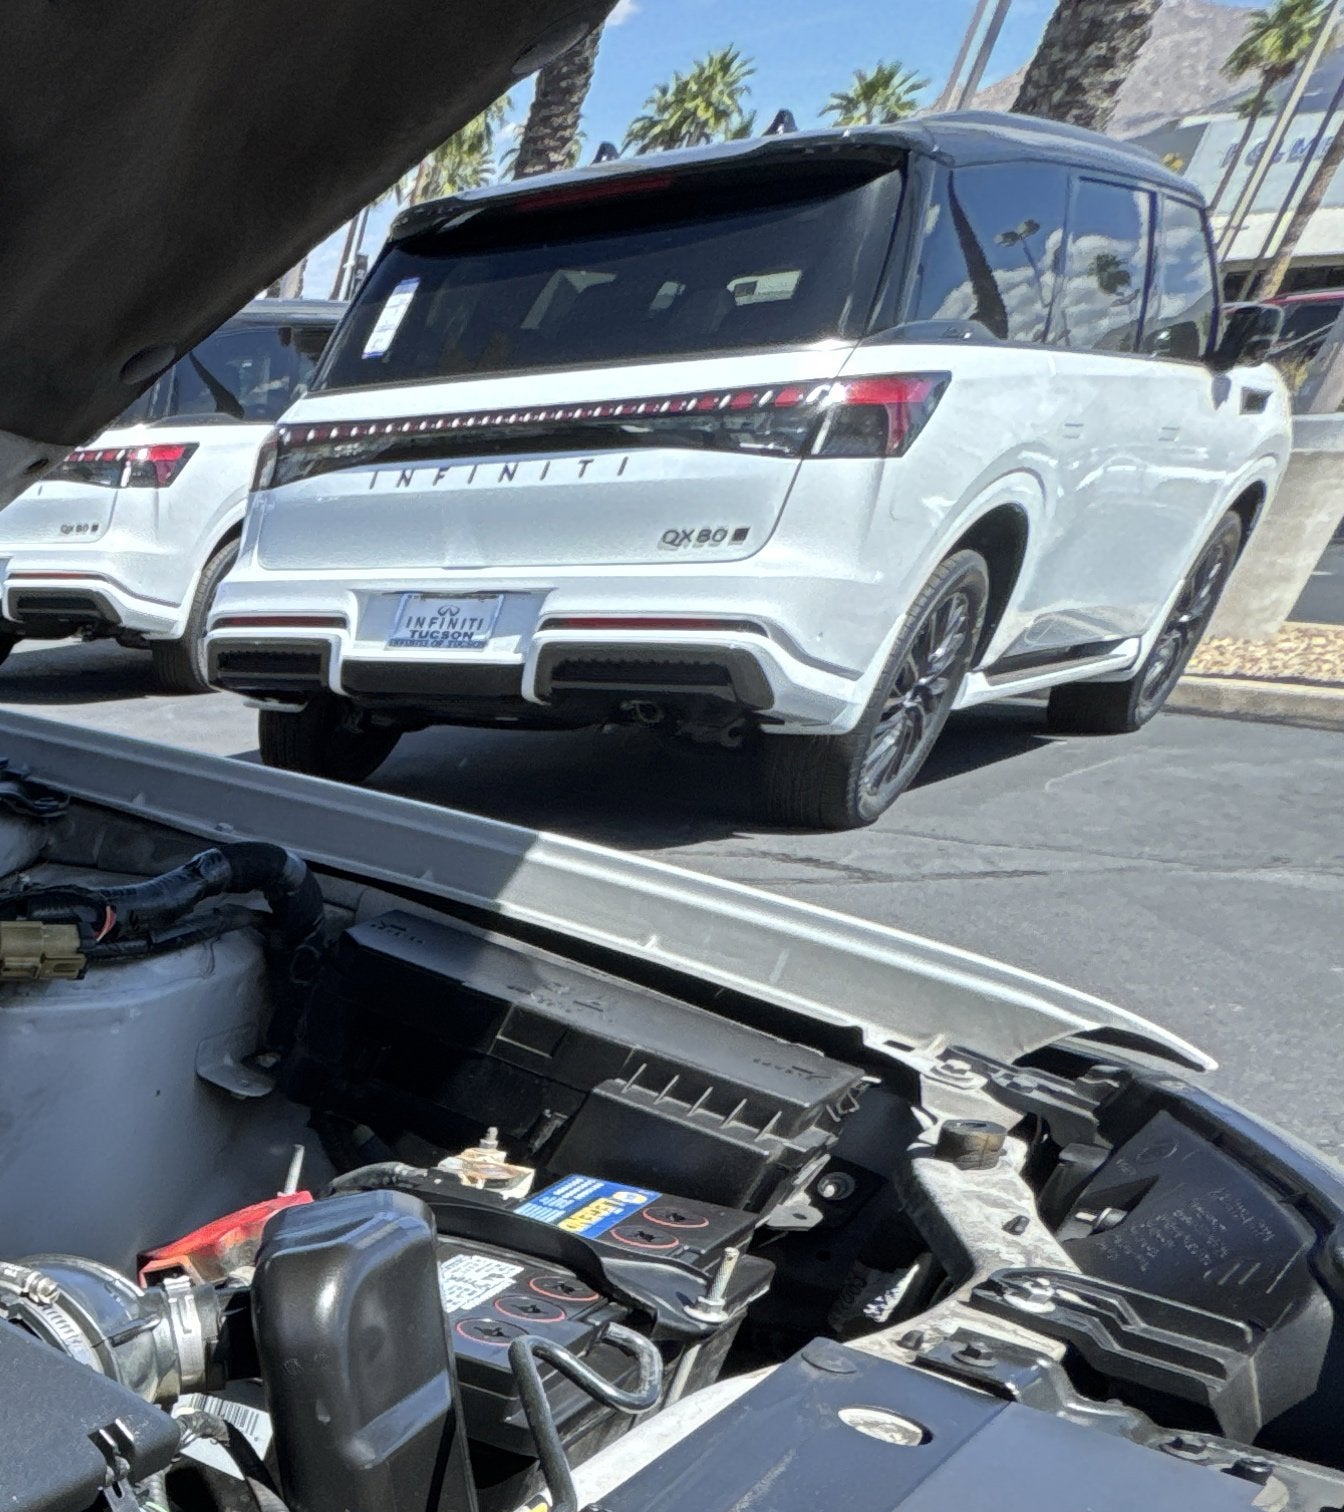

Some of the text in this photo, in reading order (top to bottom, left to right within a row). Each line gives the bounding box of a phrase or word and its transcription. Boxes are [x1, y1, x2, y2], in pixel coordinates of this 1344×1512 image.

[369, 456, 629, 490] INFINITI
[661, 527, 728, 548] QX80
[406, 616, 484, 631] INFINITI
[410, 629, 474, 640] TUCSON
